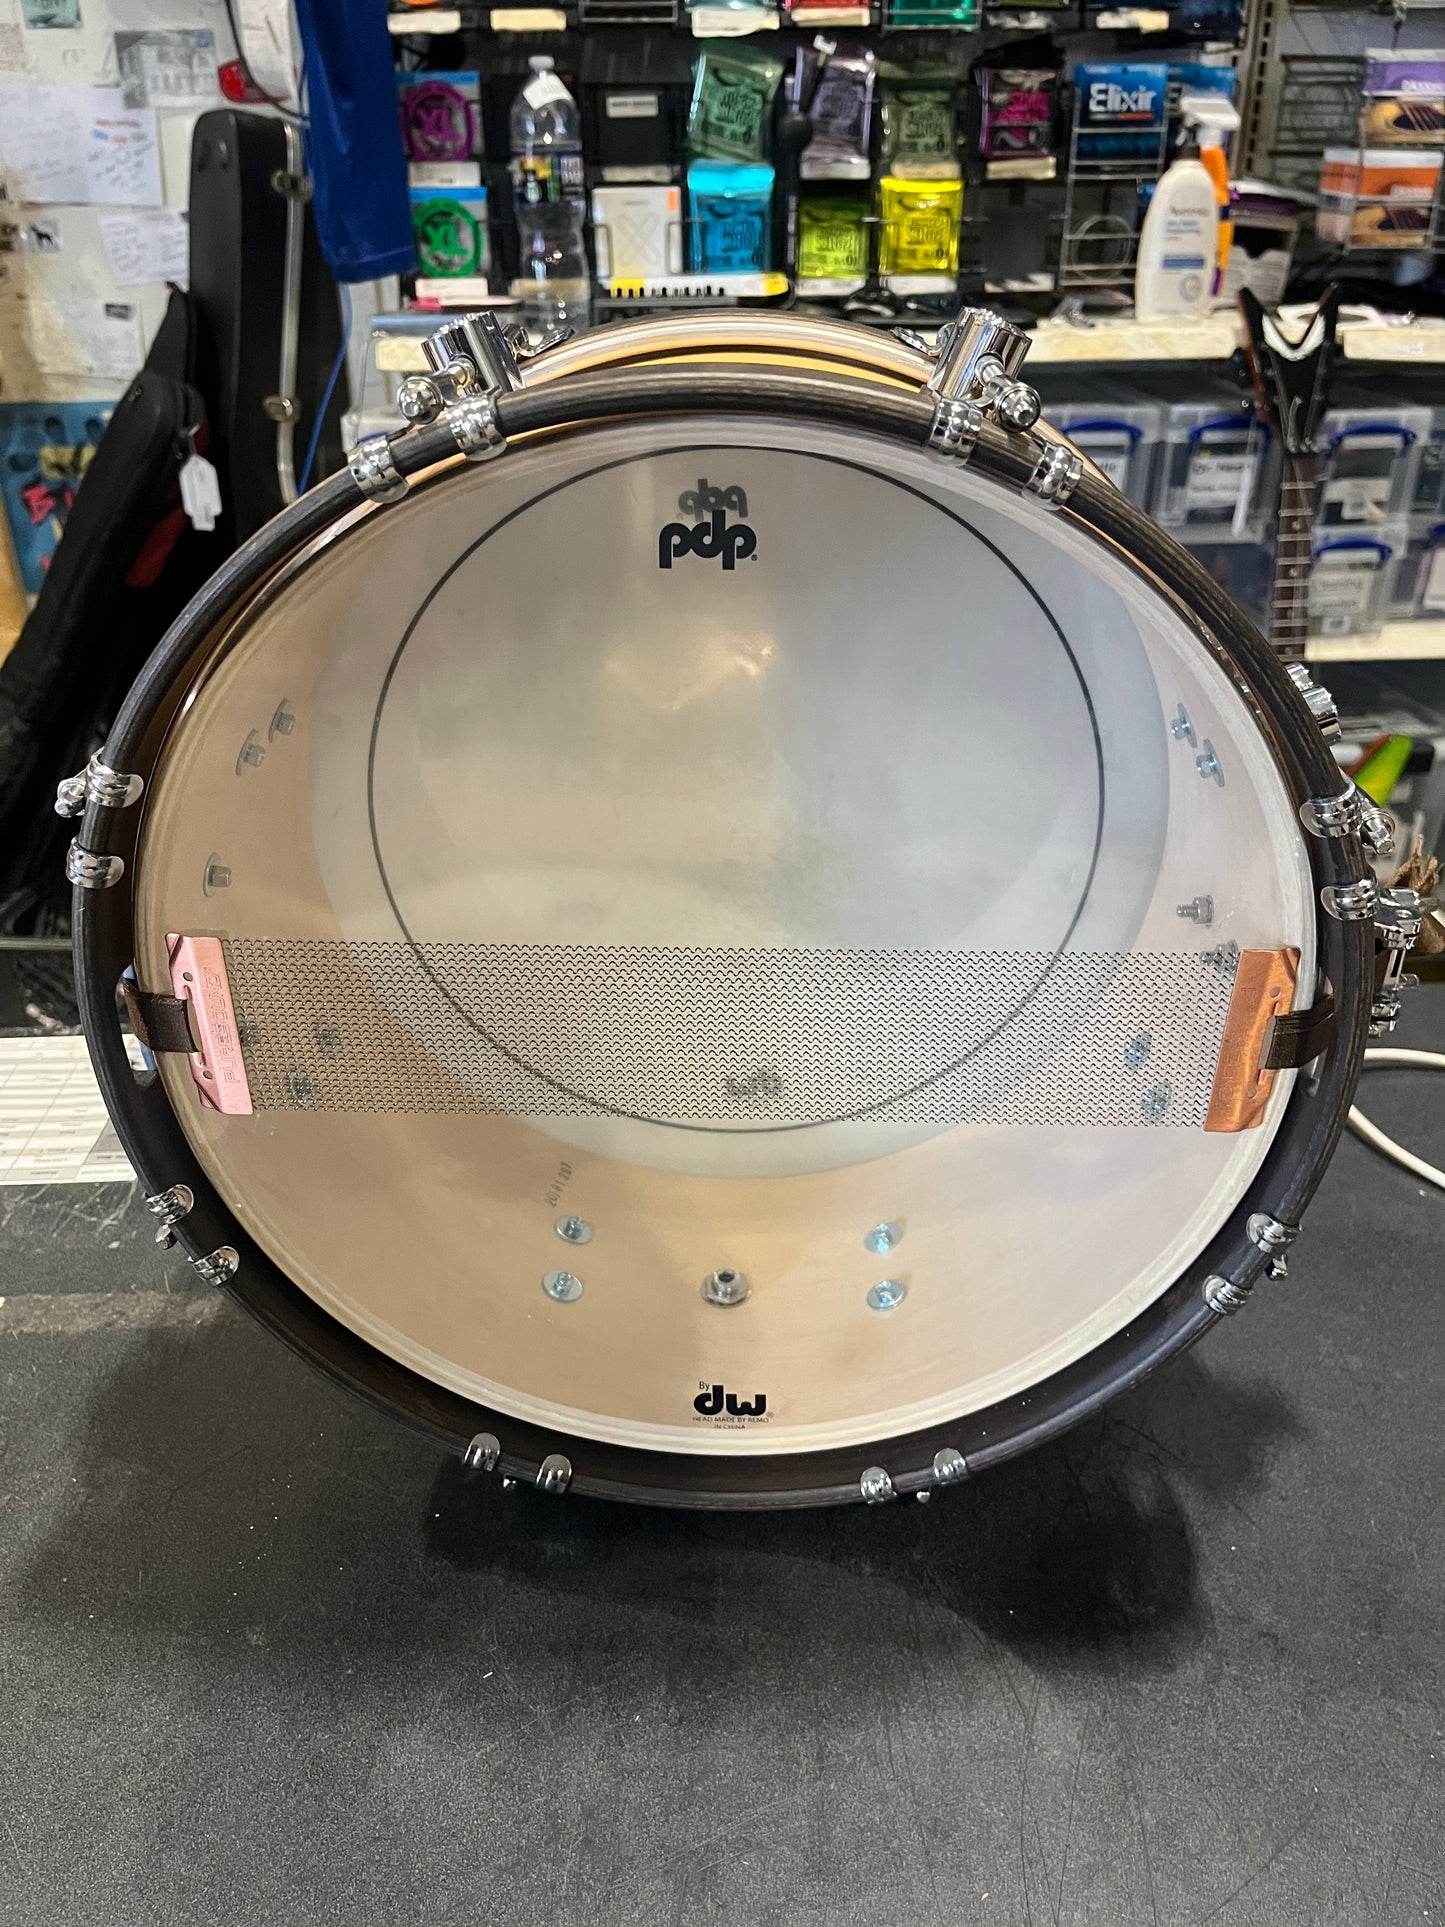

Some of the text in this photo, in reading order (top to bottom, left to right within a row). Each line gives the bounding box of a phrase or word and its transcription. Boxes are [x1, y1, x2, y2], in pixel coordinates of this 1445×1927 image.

[1089, 82, 1157, 112] Elixir
[425, 223, 468, 255] XL
[658, 509, 757, 570] pdp
[693, 1385, 767, 1416] dw
[699, 1381, 710, 1391] By
